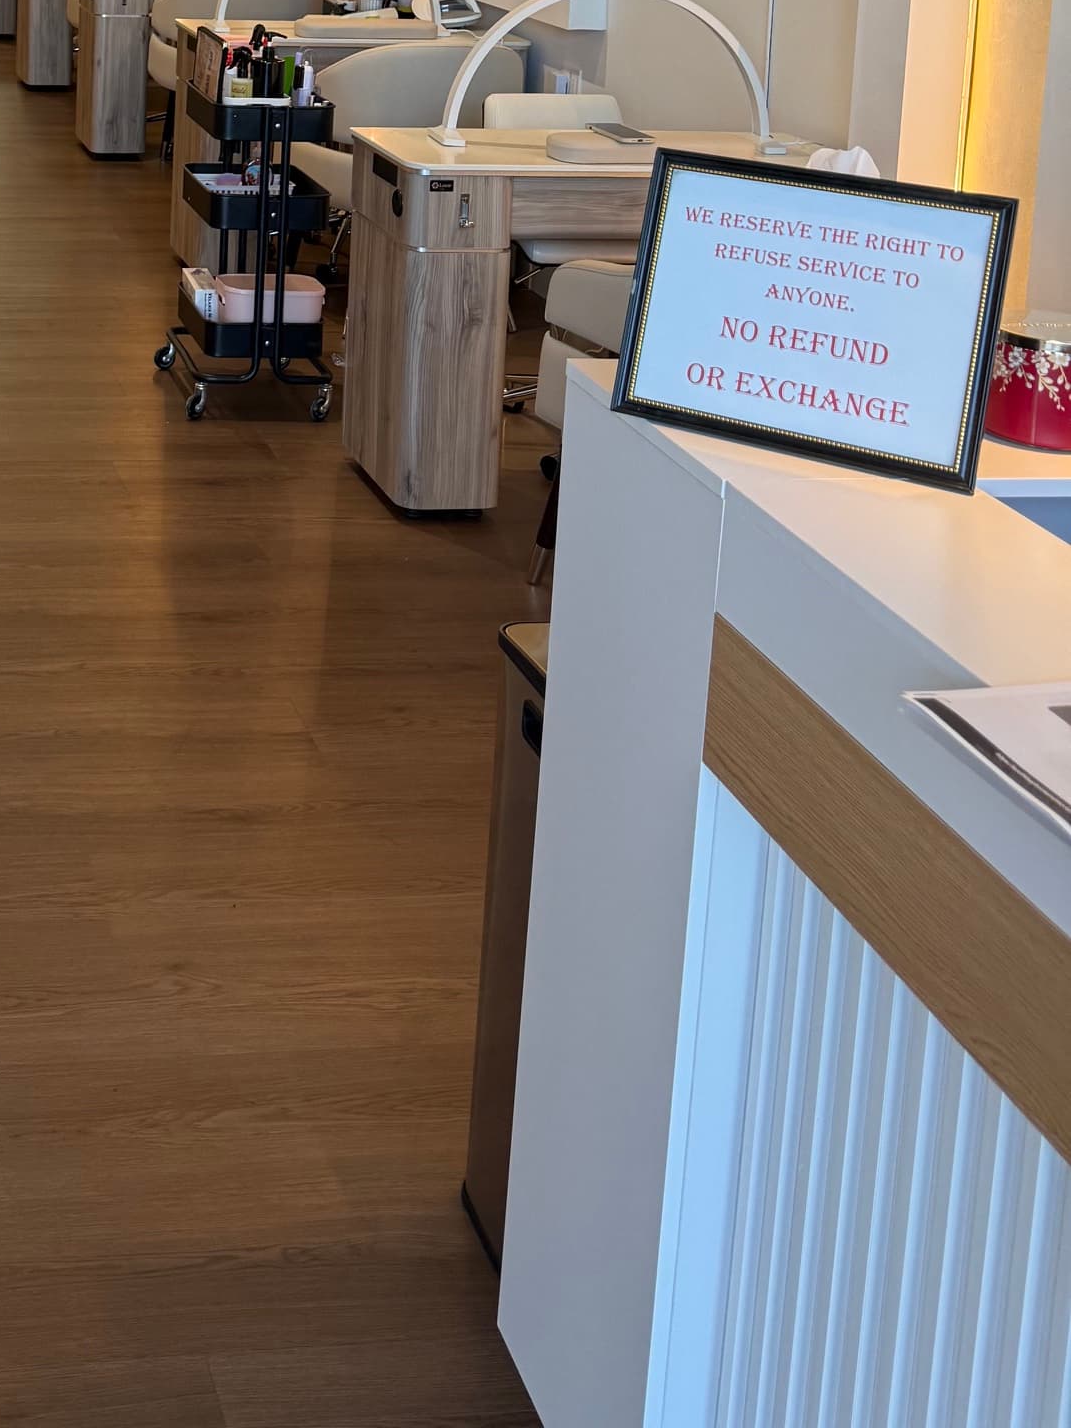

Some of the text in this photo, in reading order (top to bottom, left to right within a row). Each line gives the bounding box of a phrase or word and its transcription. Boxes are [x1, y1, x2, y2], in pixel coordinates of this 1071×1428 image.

[685, 206, 965, 262] WE RESERVE THE RIGHT TO
[714, 243, 920, 289] REFUSE SERVICE TO
[765, 283, 855, 312] ANYONE.
[719, 316, 889, 367] NO REFUND
[686, 362, 910, 427] OR EXCHANGE
